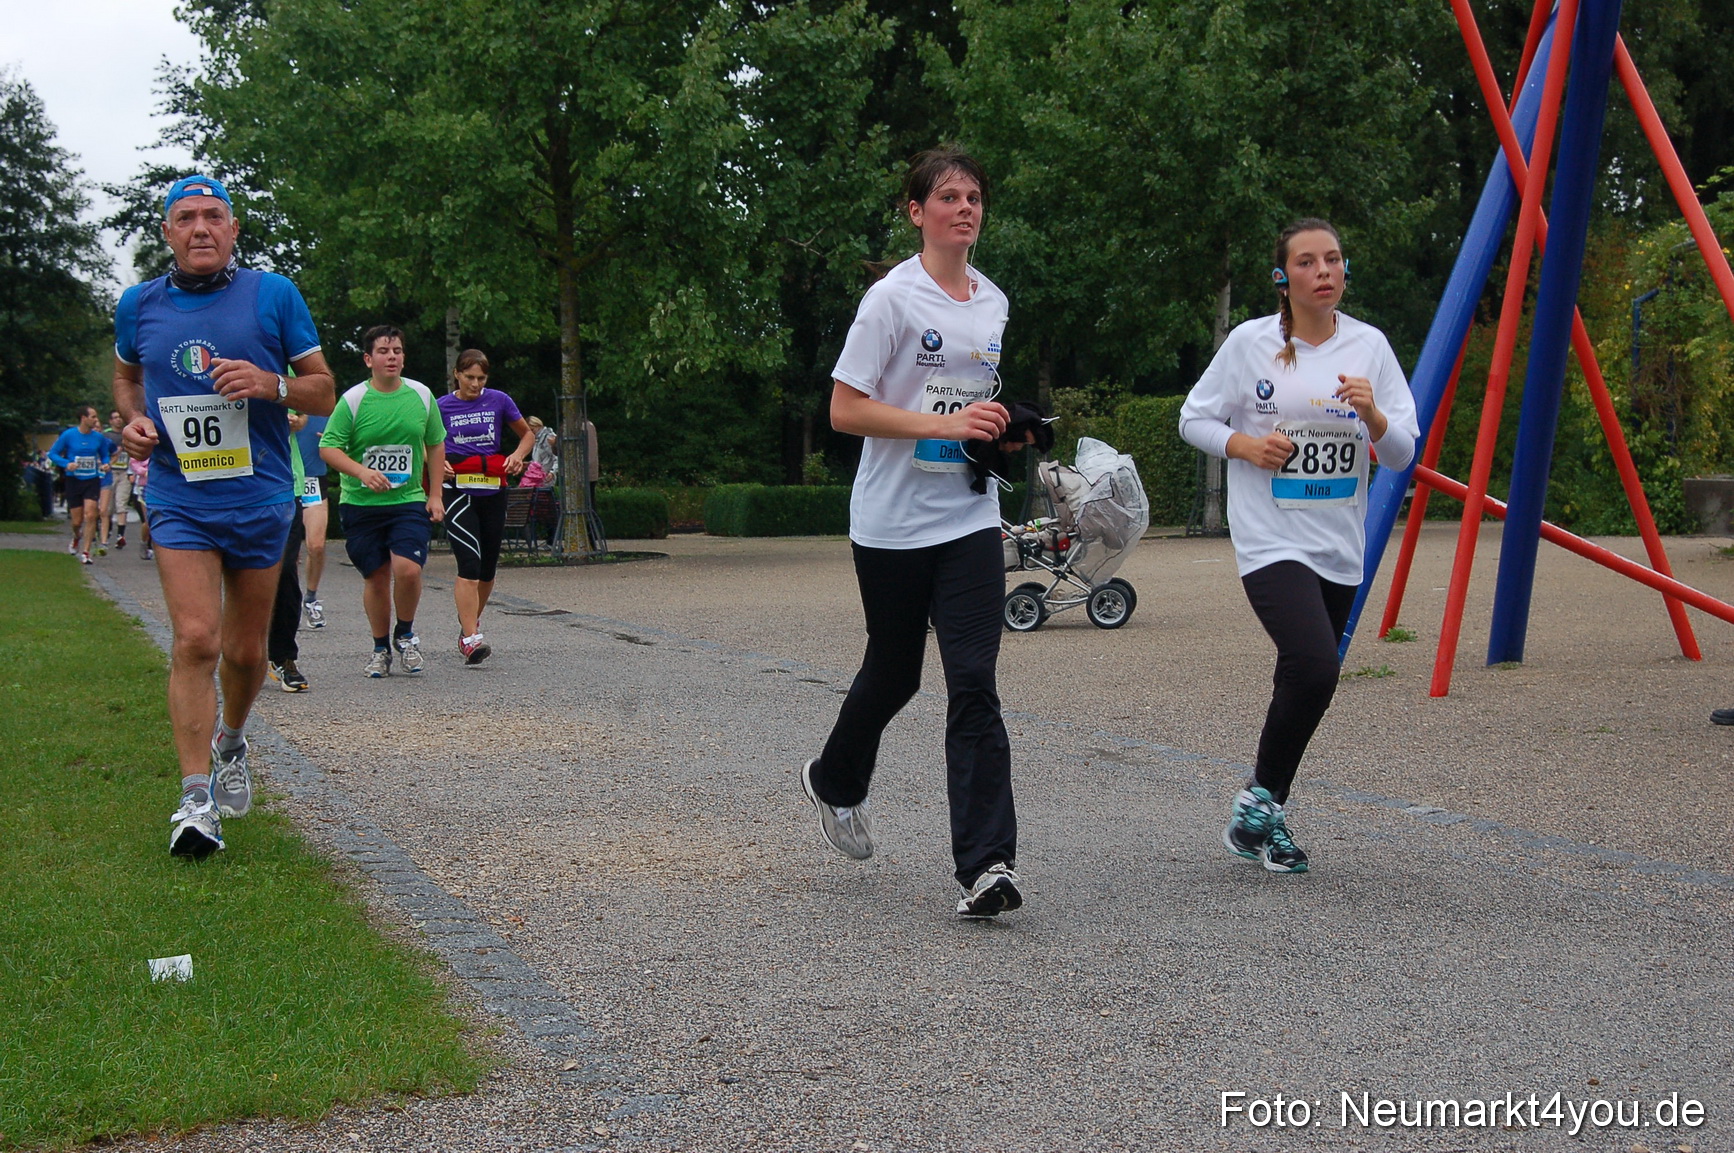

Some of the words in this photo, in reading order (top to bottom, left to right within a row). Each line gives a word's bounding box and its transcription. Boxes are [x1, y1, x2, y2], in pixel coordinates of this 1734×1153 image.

[178, 339, 216, 351] TOMMASO
[916, 353, 946, 362] PARTL
[926, 385, 954, 396] PARTL
[955, 387, 985, 398] Neumarkt
[186, 403, 232, 412] Neumarkt
[1255, 402, 1278, 410] PARTL
[450, 417, 482, 427] FINISHER
[183, 416, 222, 448] 96
[1308, 429, 1352, 438] Neumarkt
[367, 454, 408, 471] 2828
[1281, 442, 1356, 474] 2839
[468, 475, 489, 483] Renate
[1304, 484, 1331, 496] Nina
